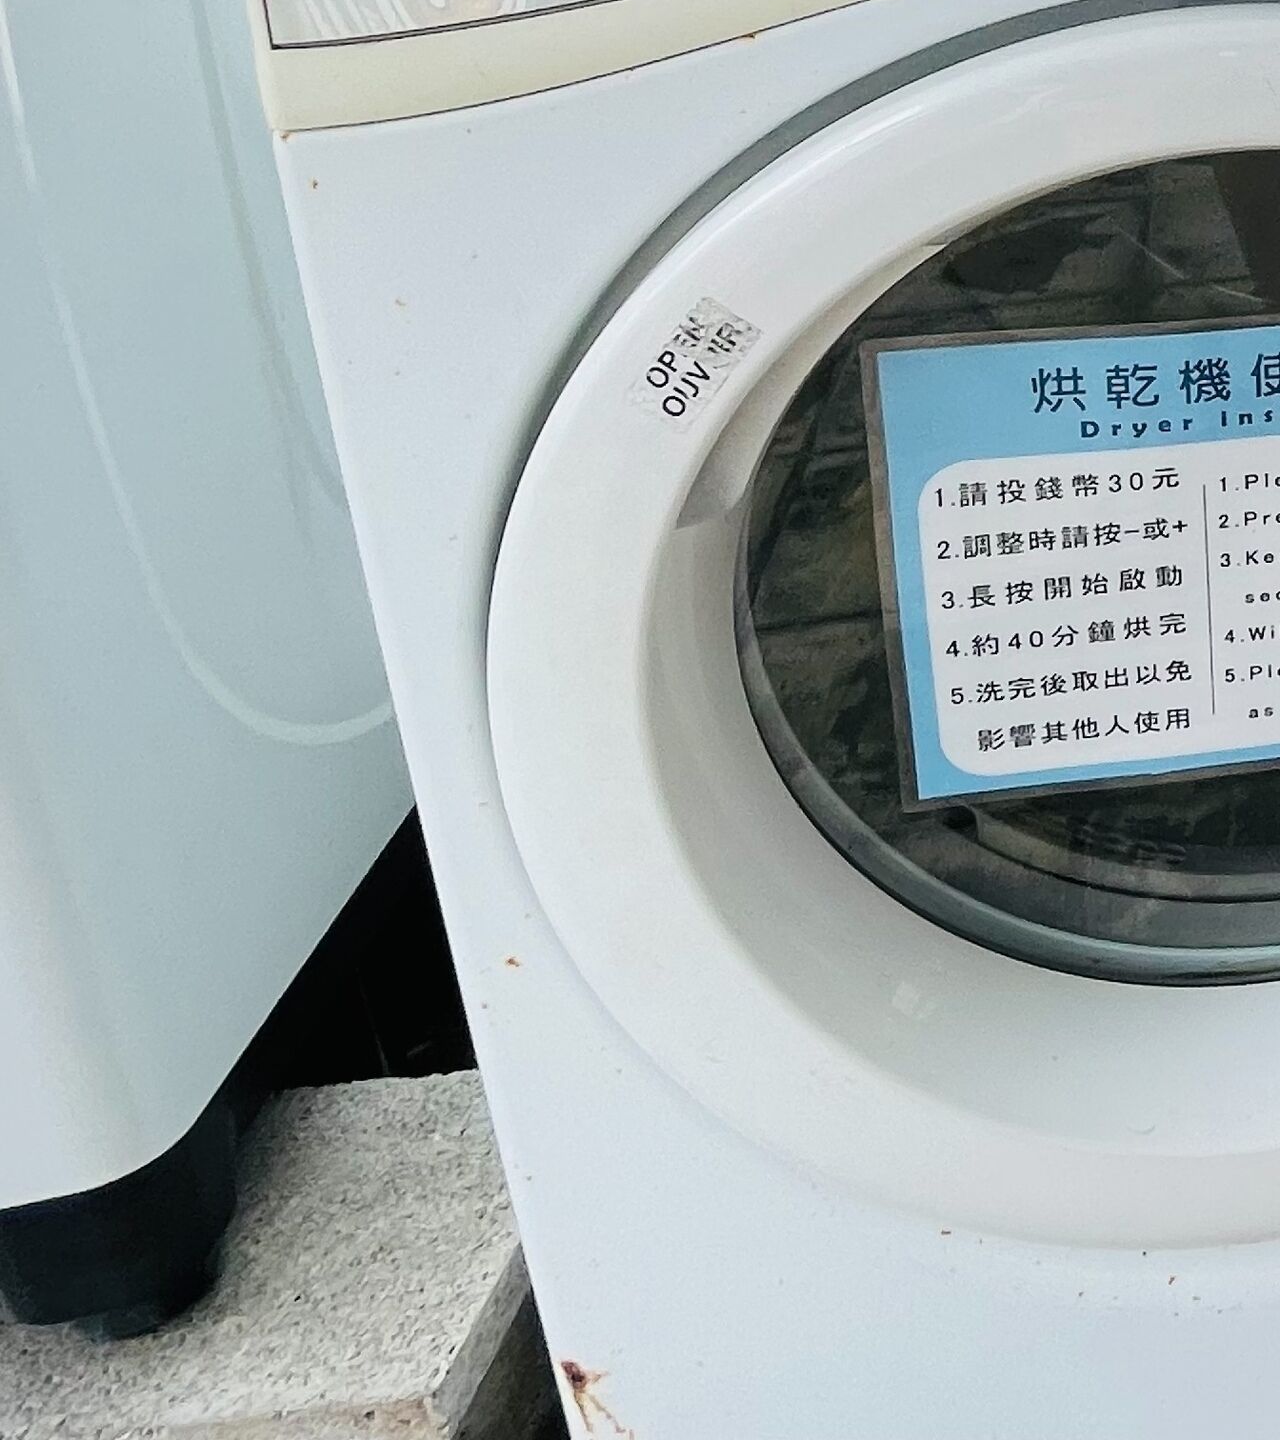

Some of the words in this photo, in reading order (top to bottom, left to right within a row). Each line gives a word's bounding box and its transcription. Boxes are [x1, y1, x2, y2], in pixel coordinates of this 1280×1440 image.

[1080, 415, 1193, 438] Dryer
[1248, 703, 1275, 719] as
[977, 708, 1191, 752] 影響其他人使用
